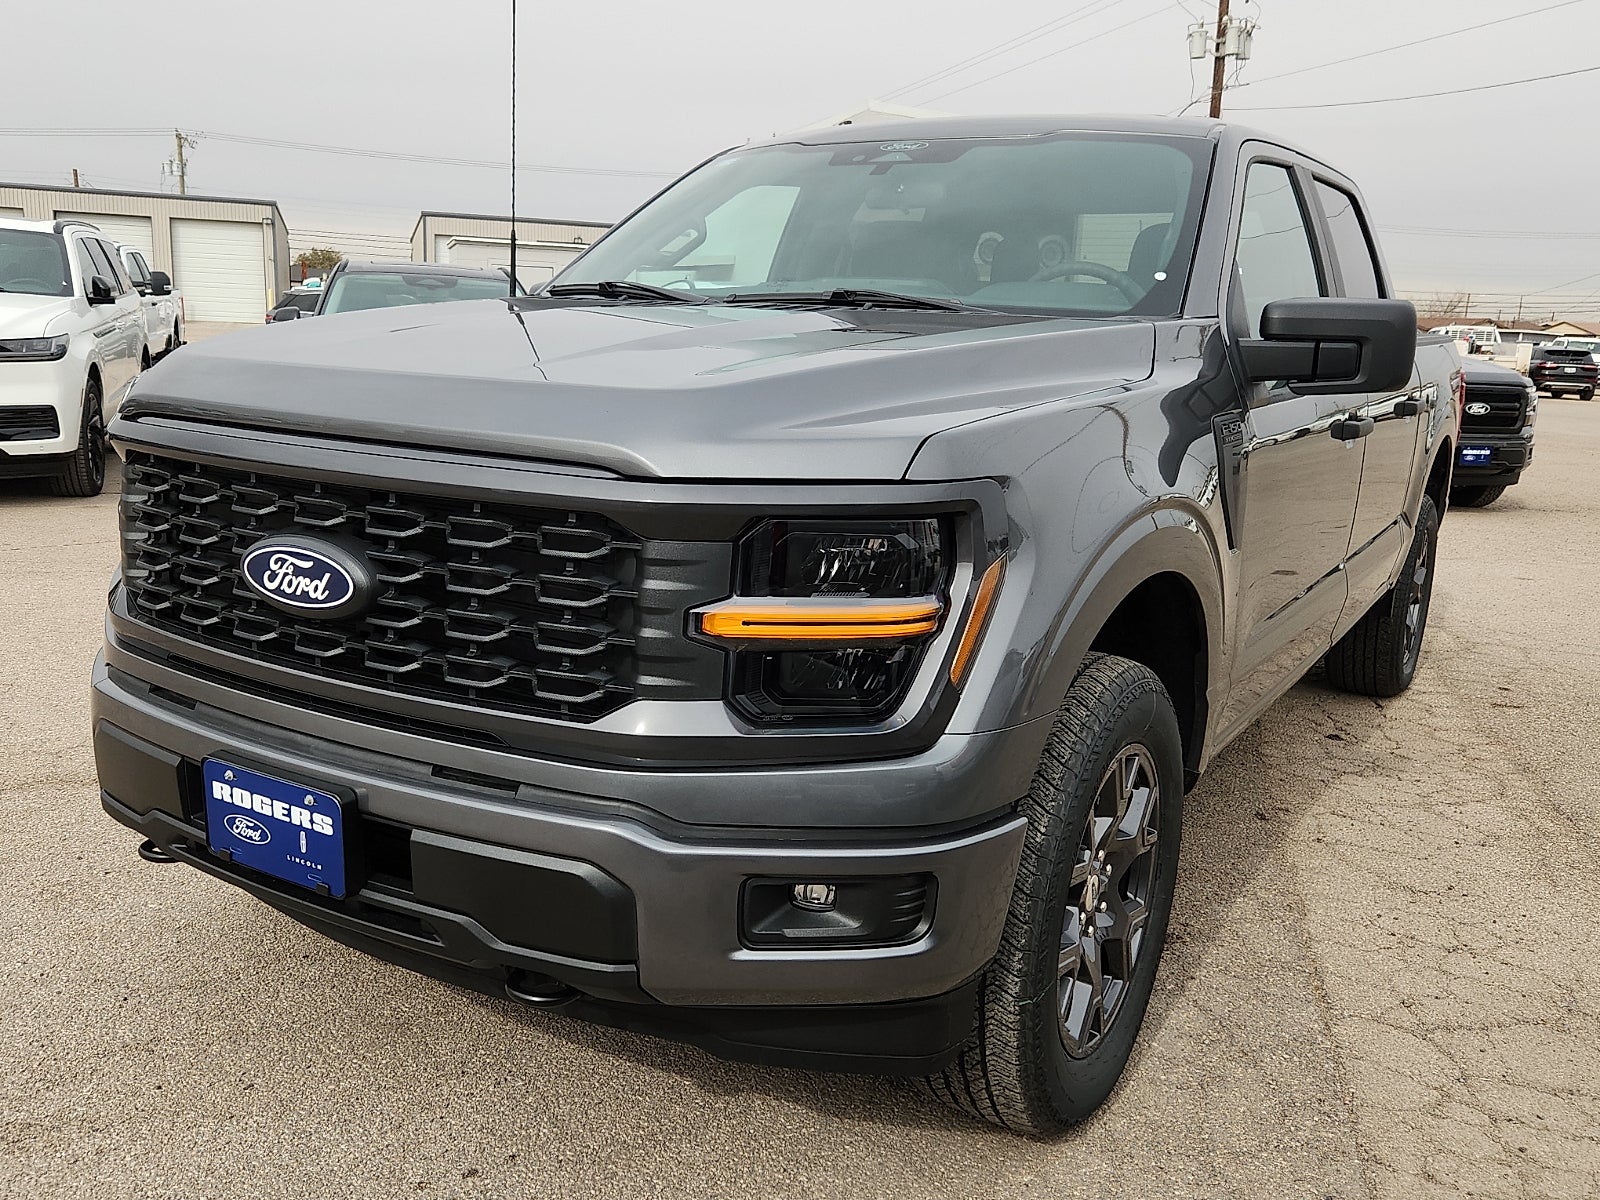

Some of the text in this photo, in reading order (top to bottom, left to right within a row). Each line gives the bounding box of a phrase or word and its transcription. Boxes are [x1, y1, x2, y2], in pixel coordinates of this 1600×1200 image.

[1469, 404, 1486, 413] Ford
[263, 553, 331, 600] Ford
[212, 781, 334, 836] ROGERS
[232, 817, 262, 842] Ford
[286, 854, 322, 871] LINCOLN
